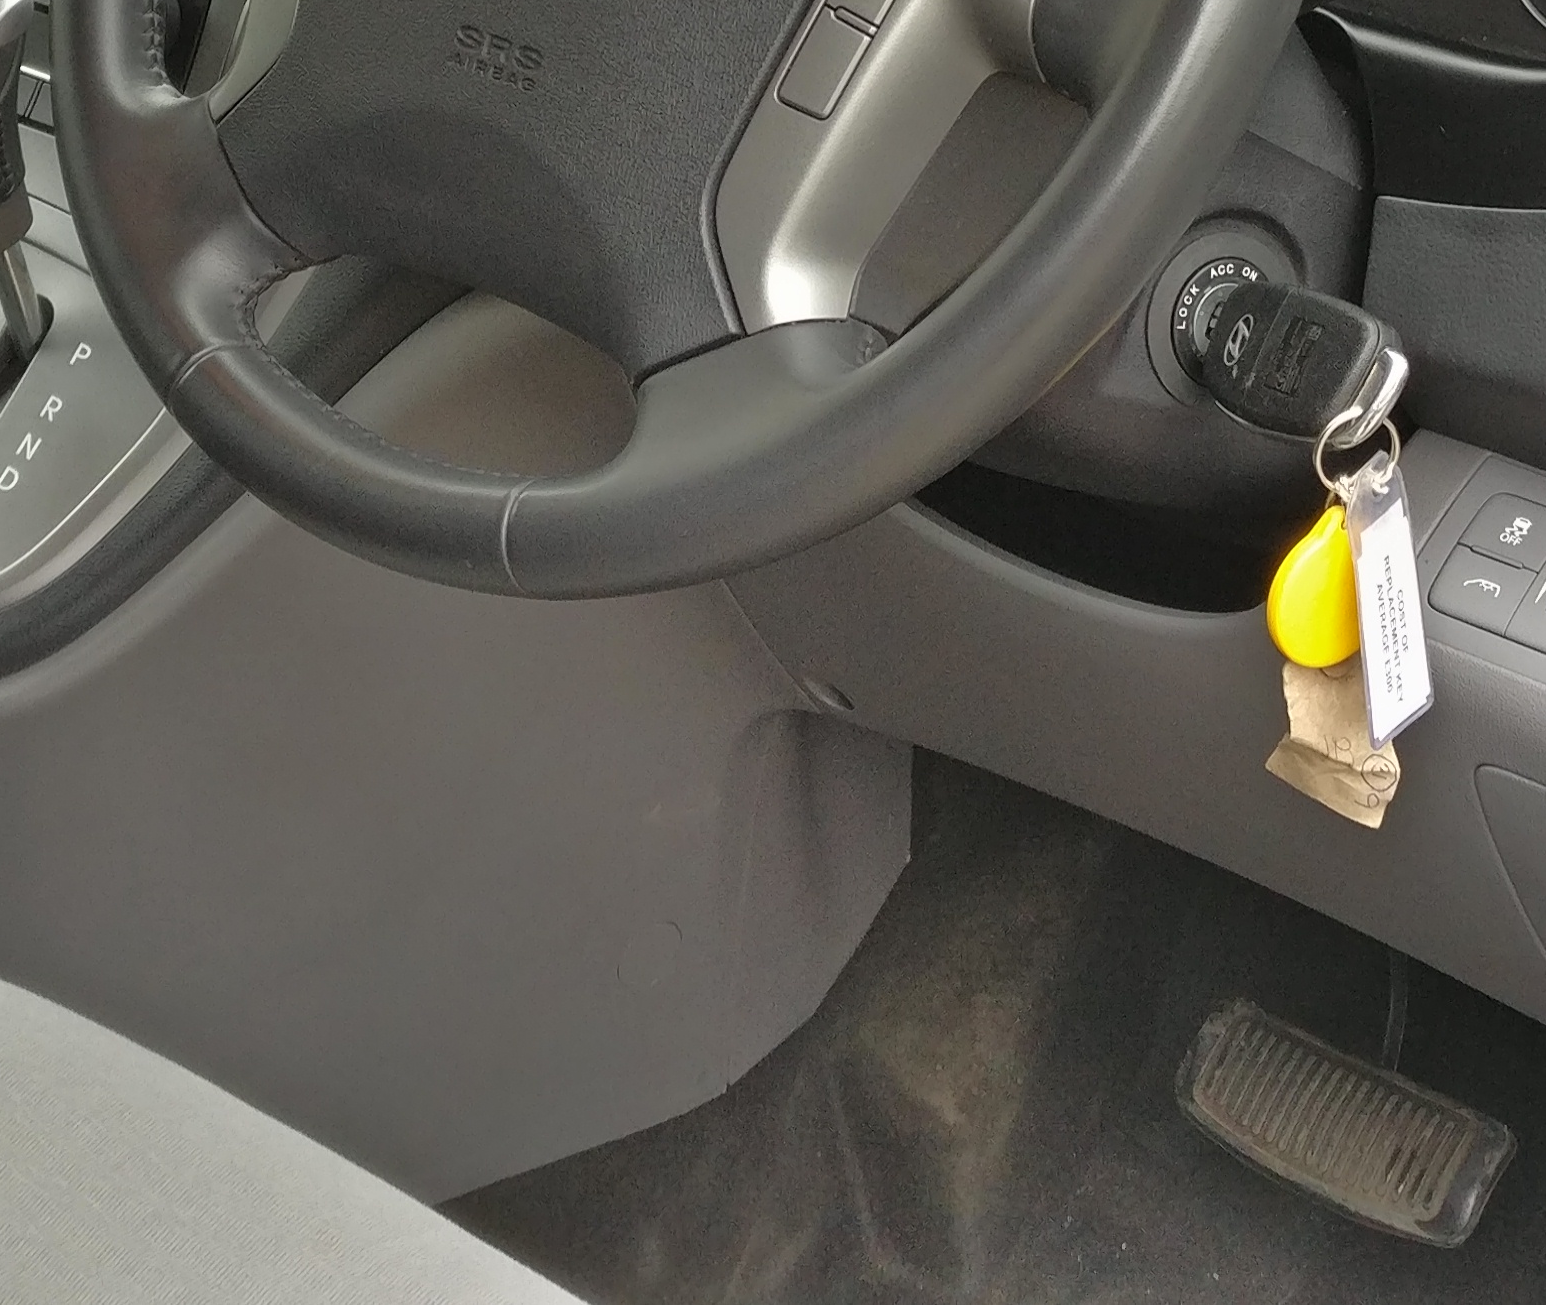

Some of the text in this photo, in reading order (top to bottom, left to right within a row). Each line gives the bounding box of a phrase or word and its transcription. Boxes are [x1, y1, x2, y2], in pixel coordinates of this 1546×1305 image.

[454, 24, 545, 70] SRS
[448, 53, 537, 93] AIRBAG
[1209, 263, 1235, 279] ACC
[1242, 266, 1258, 282] ON
[1176, 283, 1201, 330] LOCK
[69, 342, 92, 365] P
[39, 395, 63, 422] R
[15, 432, 42, 460] N
[1499, 532, 1524, 546] OFF
[1376, 583, 1390, 654] AVERAGE
[1383, 555, 1404, 702] REPLACEMENT KEY
[1397, 589, 1409, 654] COST OF
